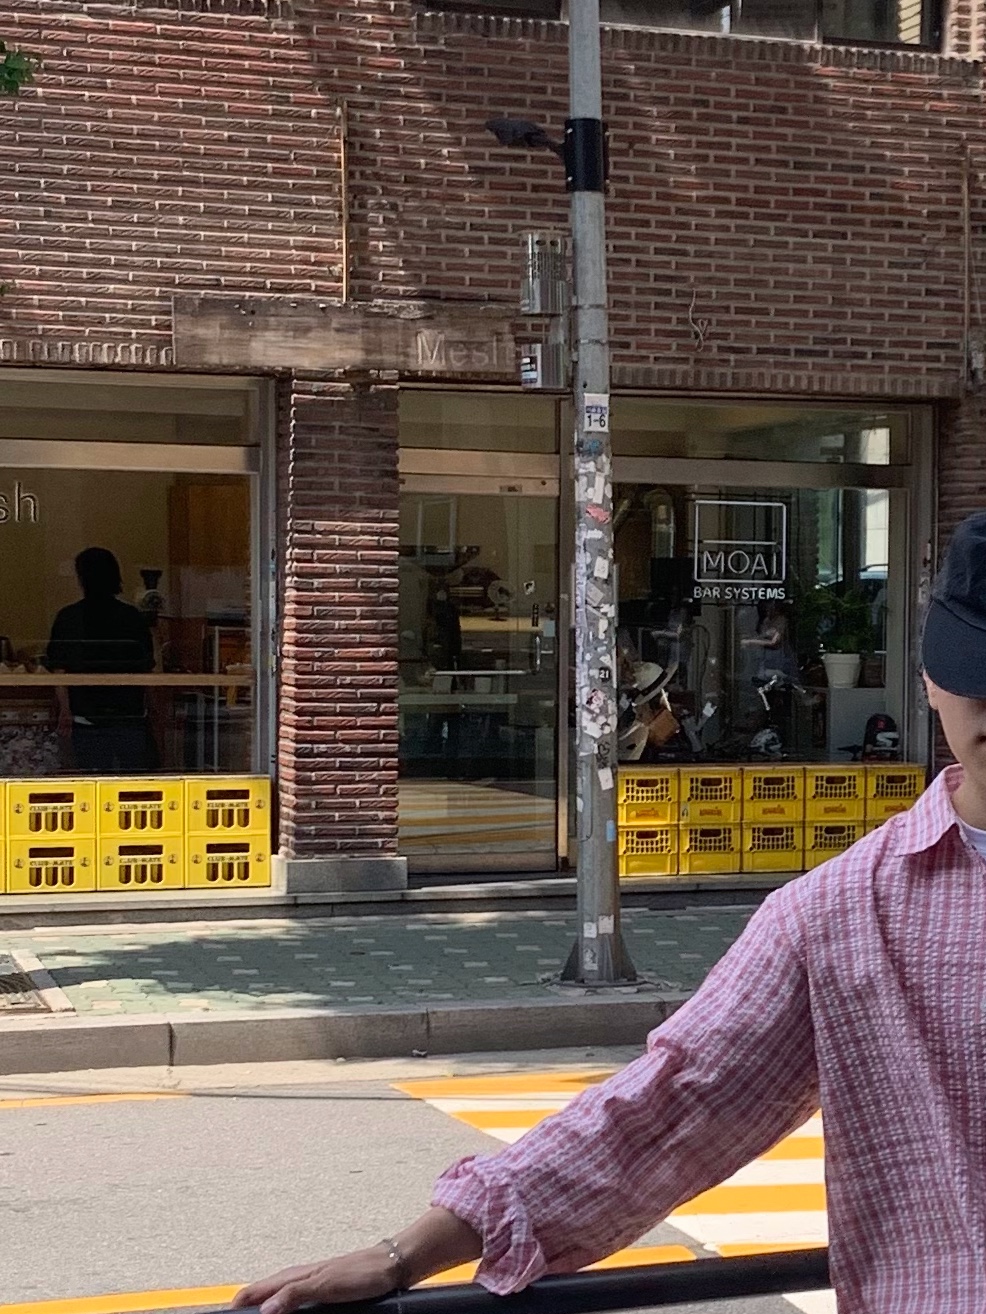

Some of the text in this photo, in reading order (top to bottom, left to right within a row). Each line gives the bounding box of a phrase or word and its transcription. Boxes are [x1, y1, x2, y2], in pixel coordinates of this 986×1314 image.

[587, 413, 606, 428] 1-6
[703, 550, 777, 575] MOAI
[693, 586, 786, 599] BAR SYSTEMS
